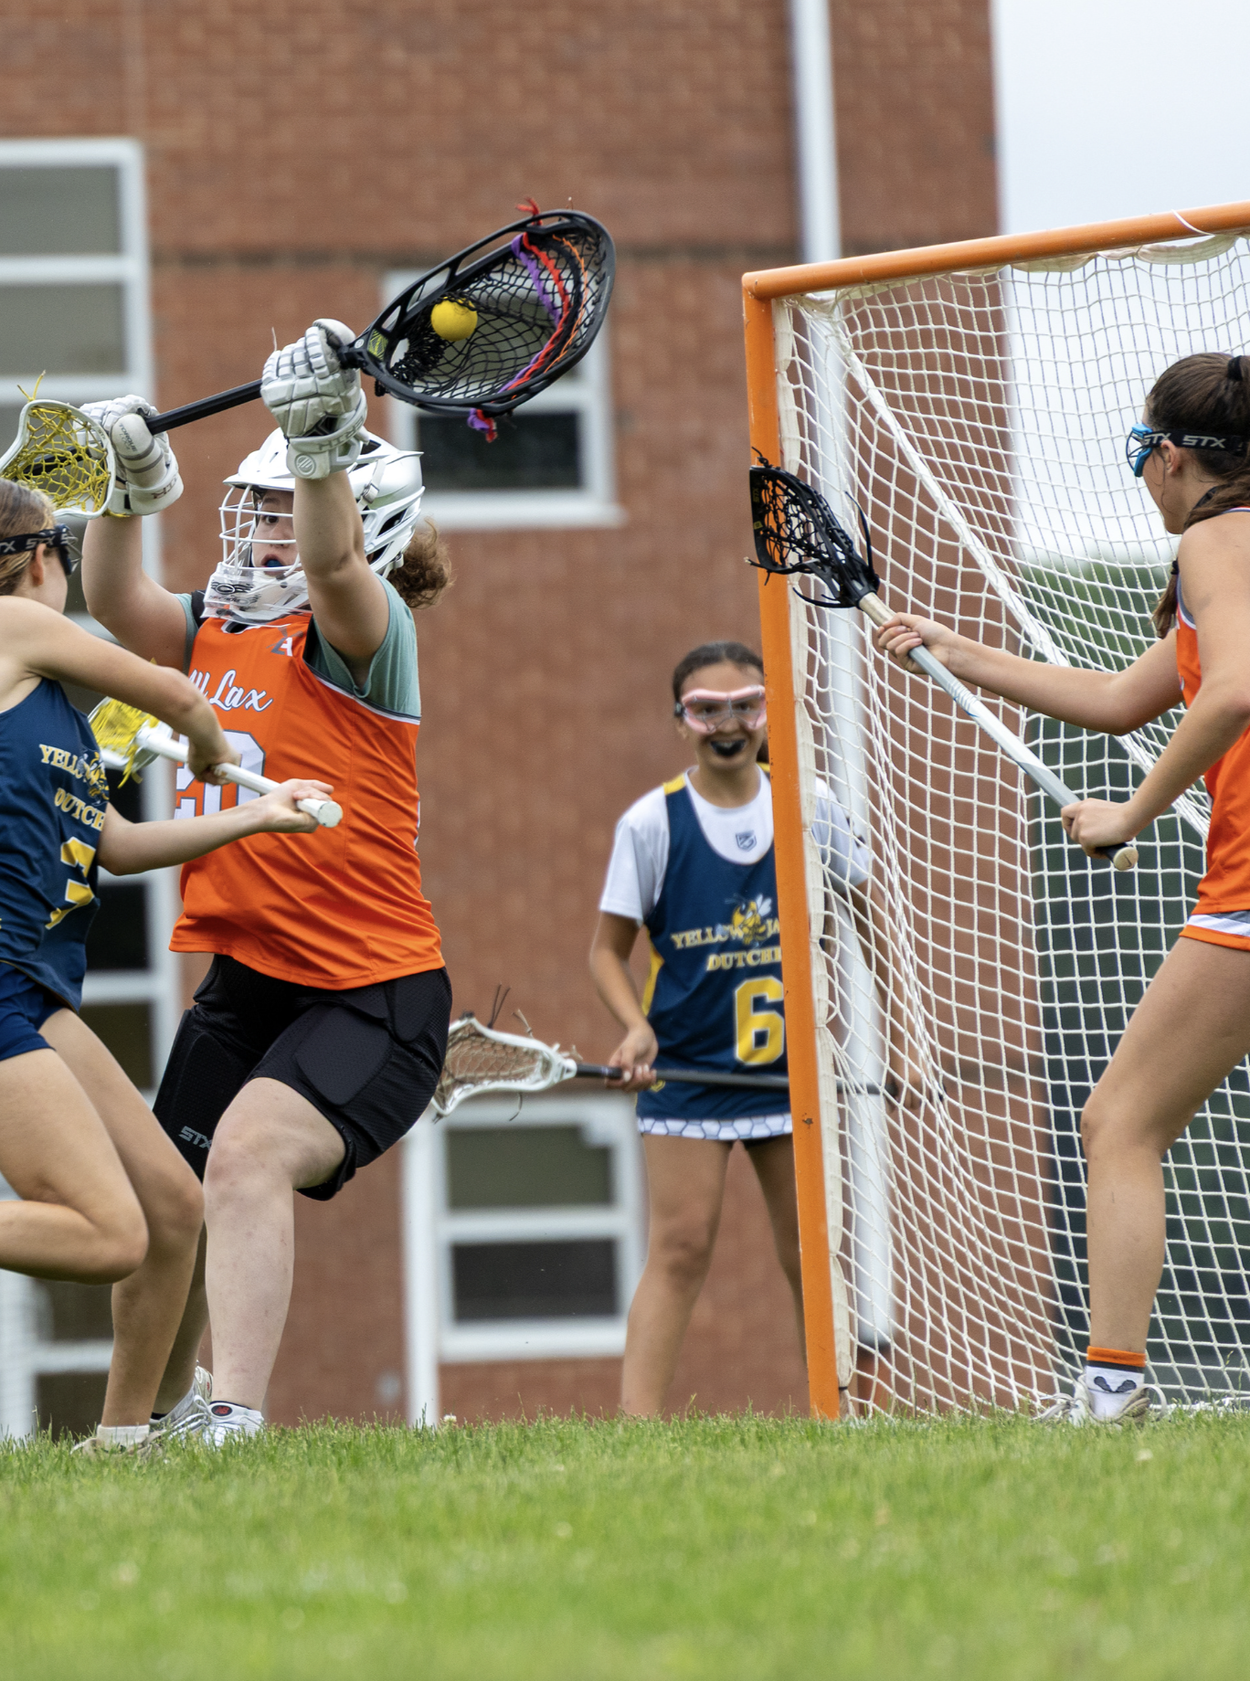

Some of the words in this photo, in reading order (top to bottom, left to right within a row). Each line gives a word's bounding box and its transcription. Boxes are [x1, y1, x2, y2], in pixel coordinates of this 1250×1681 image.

[1182, 434, 1226, 448] STX
[209, 668, 274, 712] Lax
[734, 975, 785, 1066] 6
[179, 1125, 212, 1150] STX
